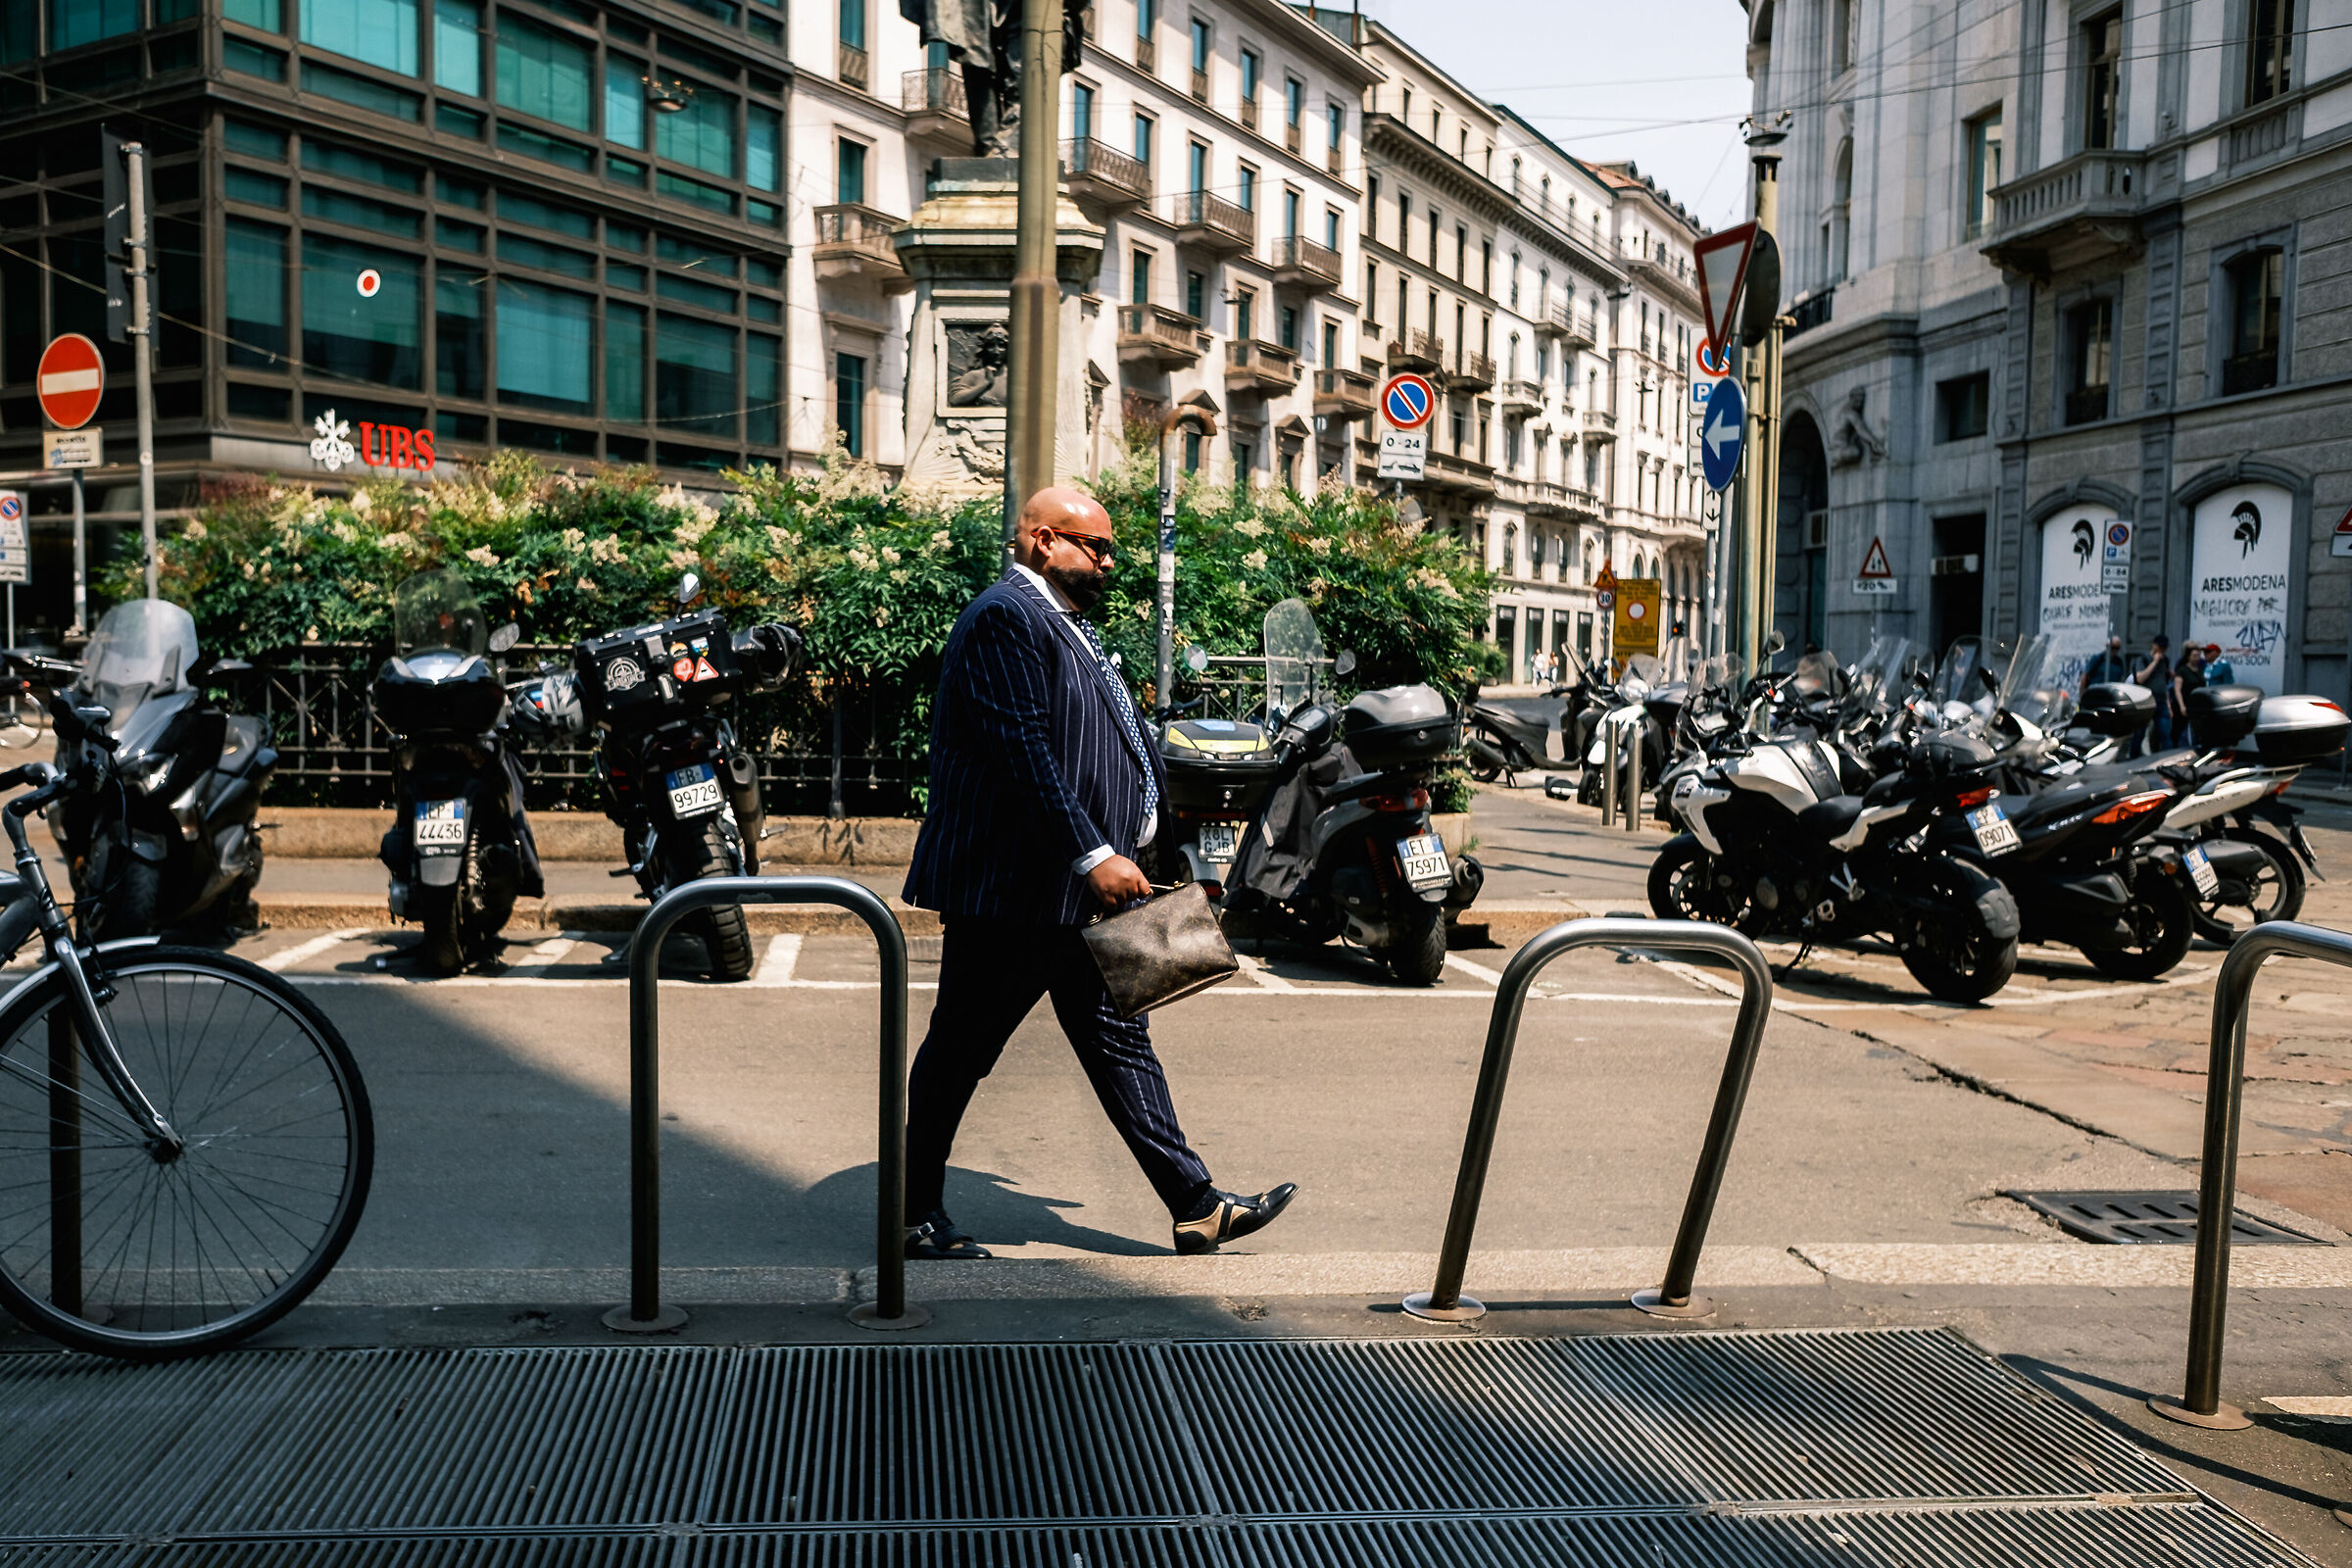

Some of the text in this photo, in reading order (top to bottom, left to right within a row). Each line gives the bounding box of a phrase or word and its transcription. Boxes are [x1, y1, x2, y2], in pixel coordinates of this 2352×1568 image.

[359, 421, 435, 471] UBS
[2048, 583, 2101, 600] ARESMODE
[2202, 574, 2286, 593] ARESMODENA
[677, 768, 696, 786] FB
[674, 784, 718, 808] 99729
[419, 823, 463, 840] 44436
[1979, 824, 2015, 848] 09071
[1409, 838, 1425, 856] ET
[1406, 857, 1446, 877] 75971
